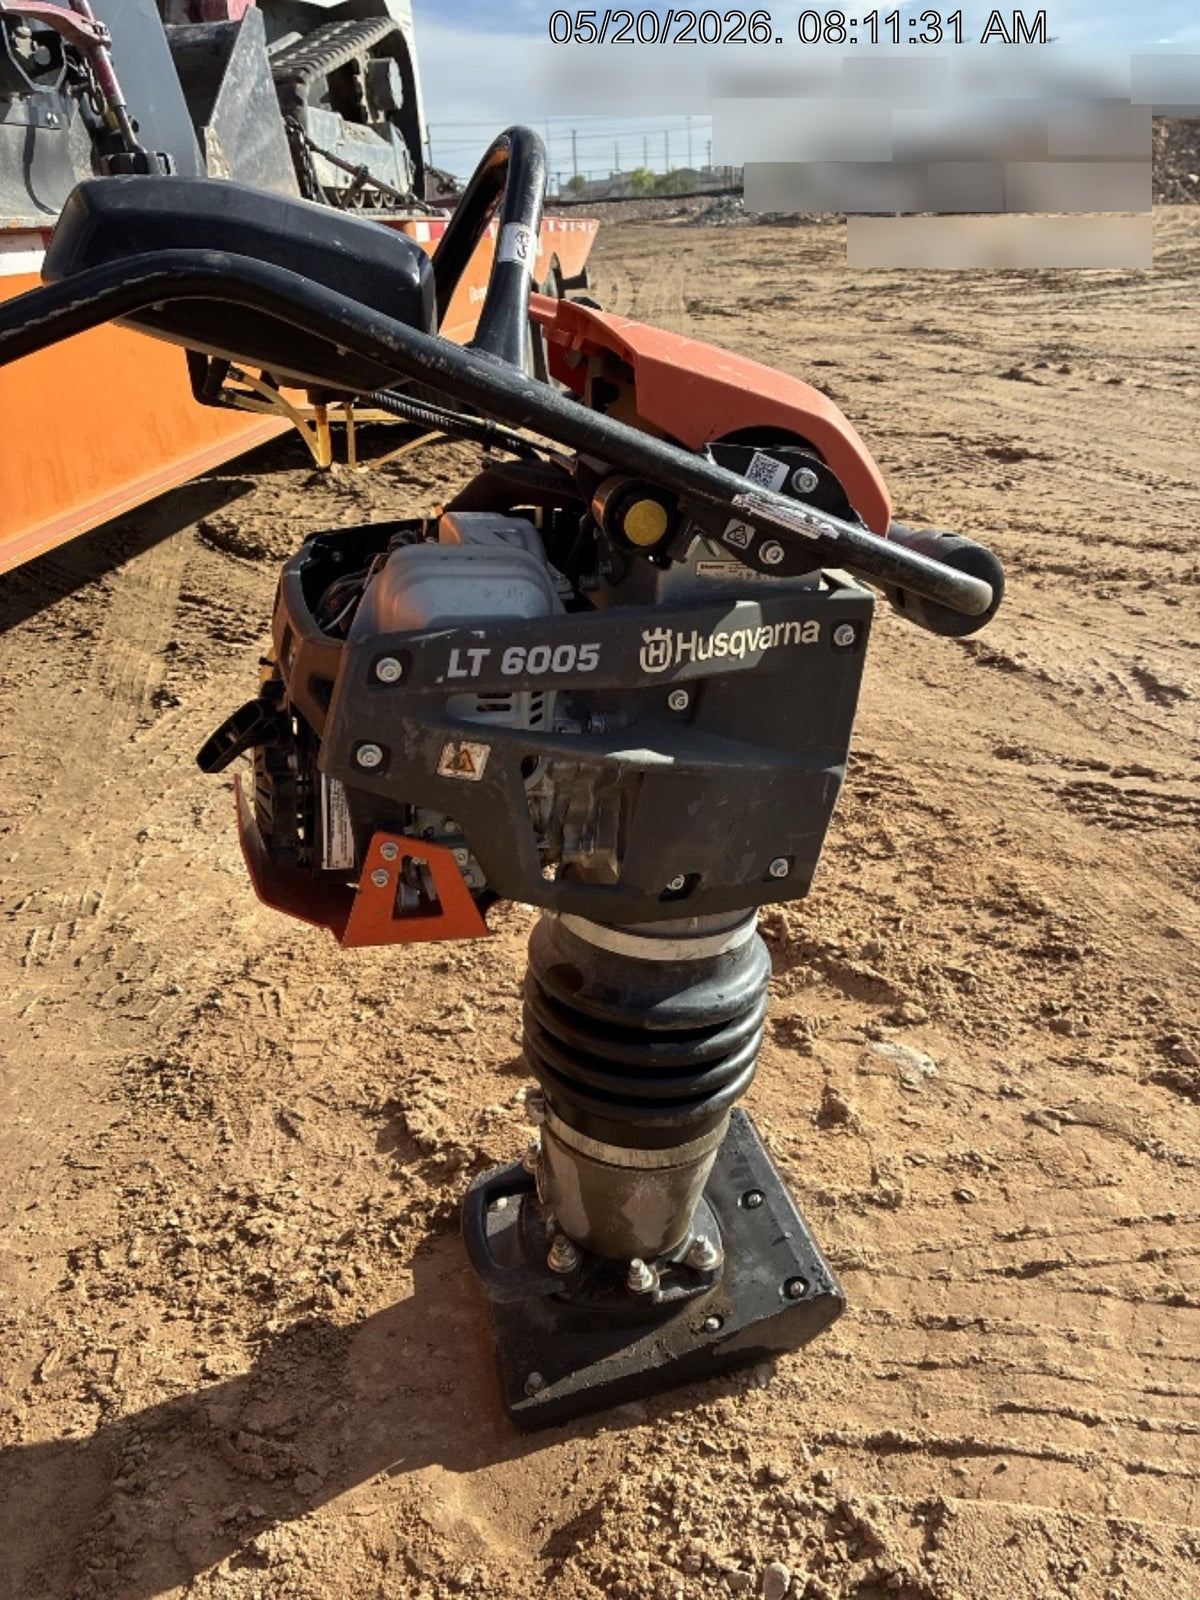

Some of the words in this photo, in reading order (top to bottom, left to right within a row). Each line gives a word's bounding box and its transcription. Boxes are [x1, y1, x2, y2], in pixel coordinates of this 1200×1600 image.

[447, 647, 491, 678] LT
[501, 642, 602, 675] 6005
[675, 619, 821, 664] Husqvarna
